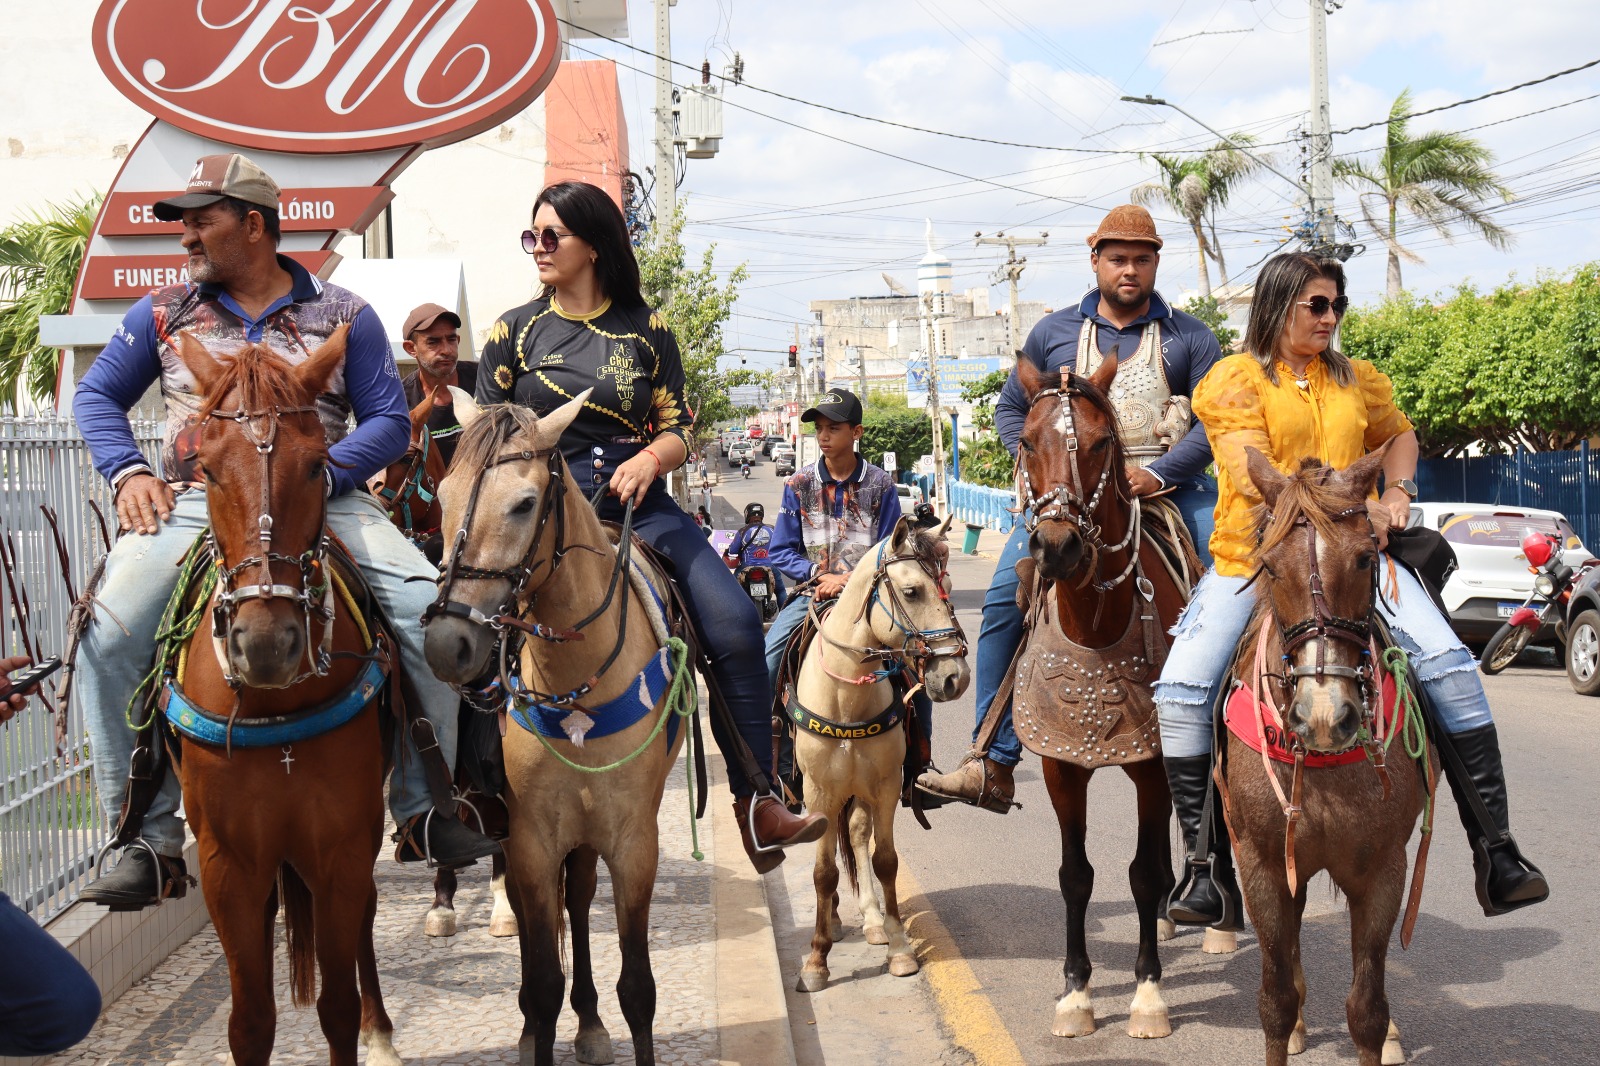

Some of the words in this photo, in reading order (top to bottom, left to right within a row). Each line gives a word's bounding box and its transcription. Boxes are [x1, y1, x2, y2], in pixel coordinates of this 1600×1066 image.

[278, 197, 335, 220] LÓRIO
[114, 263, 191, 288] FUNERÁ
[609, 355, 634, 370] CRUZ
[617, 390, 635, 401] LUZ
[808, 718, 882, 739] RAMBO
